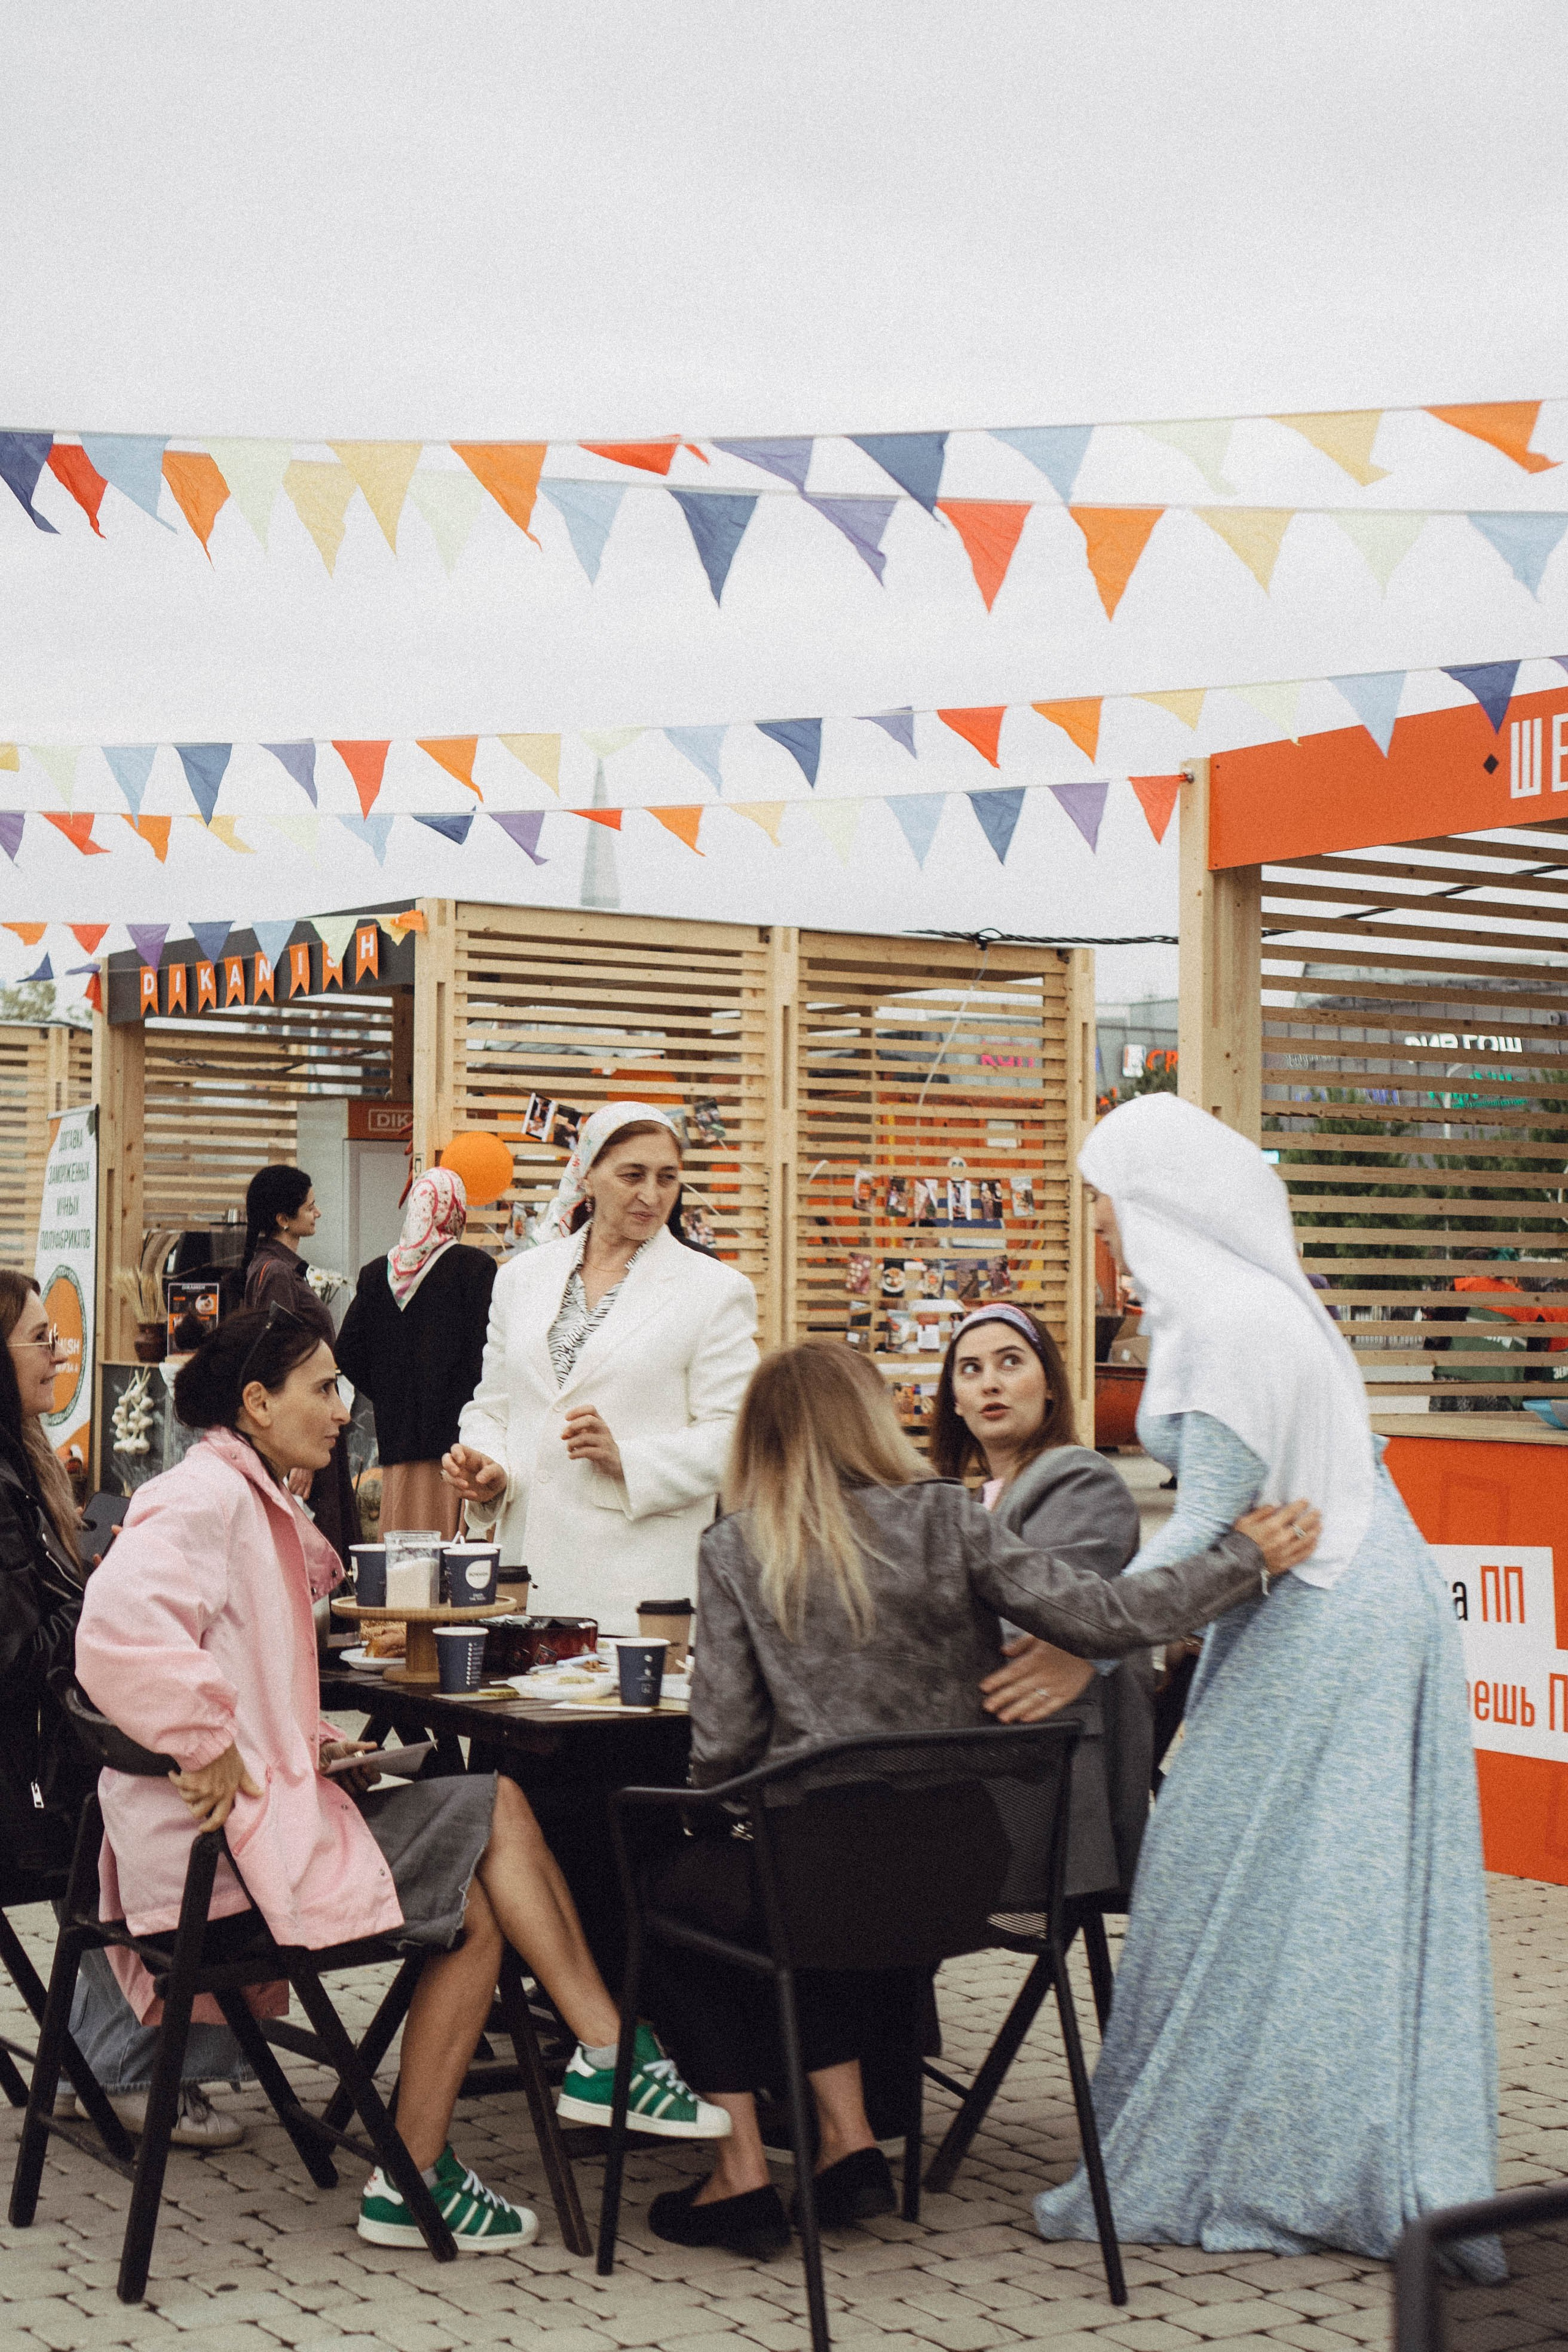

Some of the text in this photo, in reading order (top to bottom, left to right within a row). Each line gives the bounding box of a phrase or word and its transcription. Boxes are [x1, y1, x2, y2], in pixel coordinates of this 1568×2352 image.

[1510, 713, 1568, 799] ШЕ
[1444, 1566, 1526, 1624] а ПП
[1466, 1679, 1536, 1727] ешь
